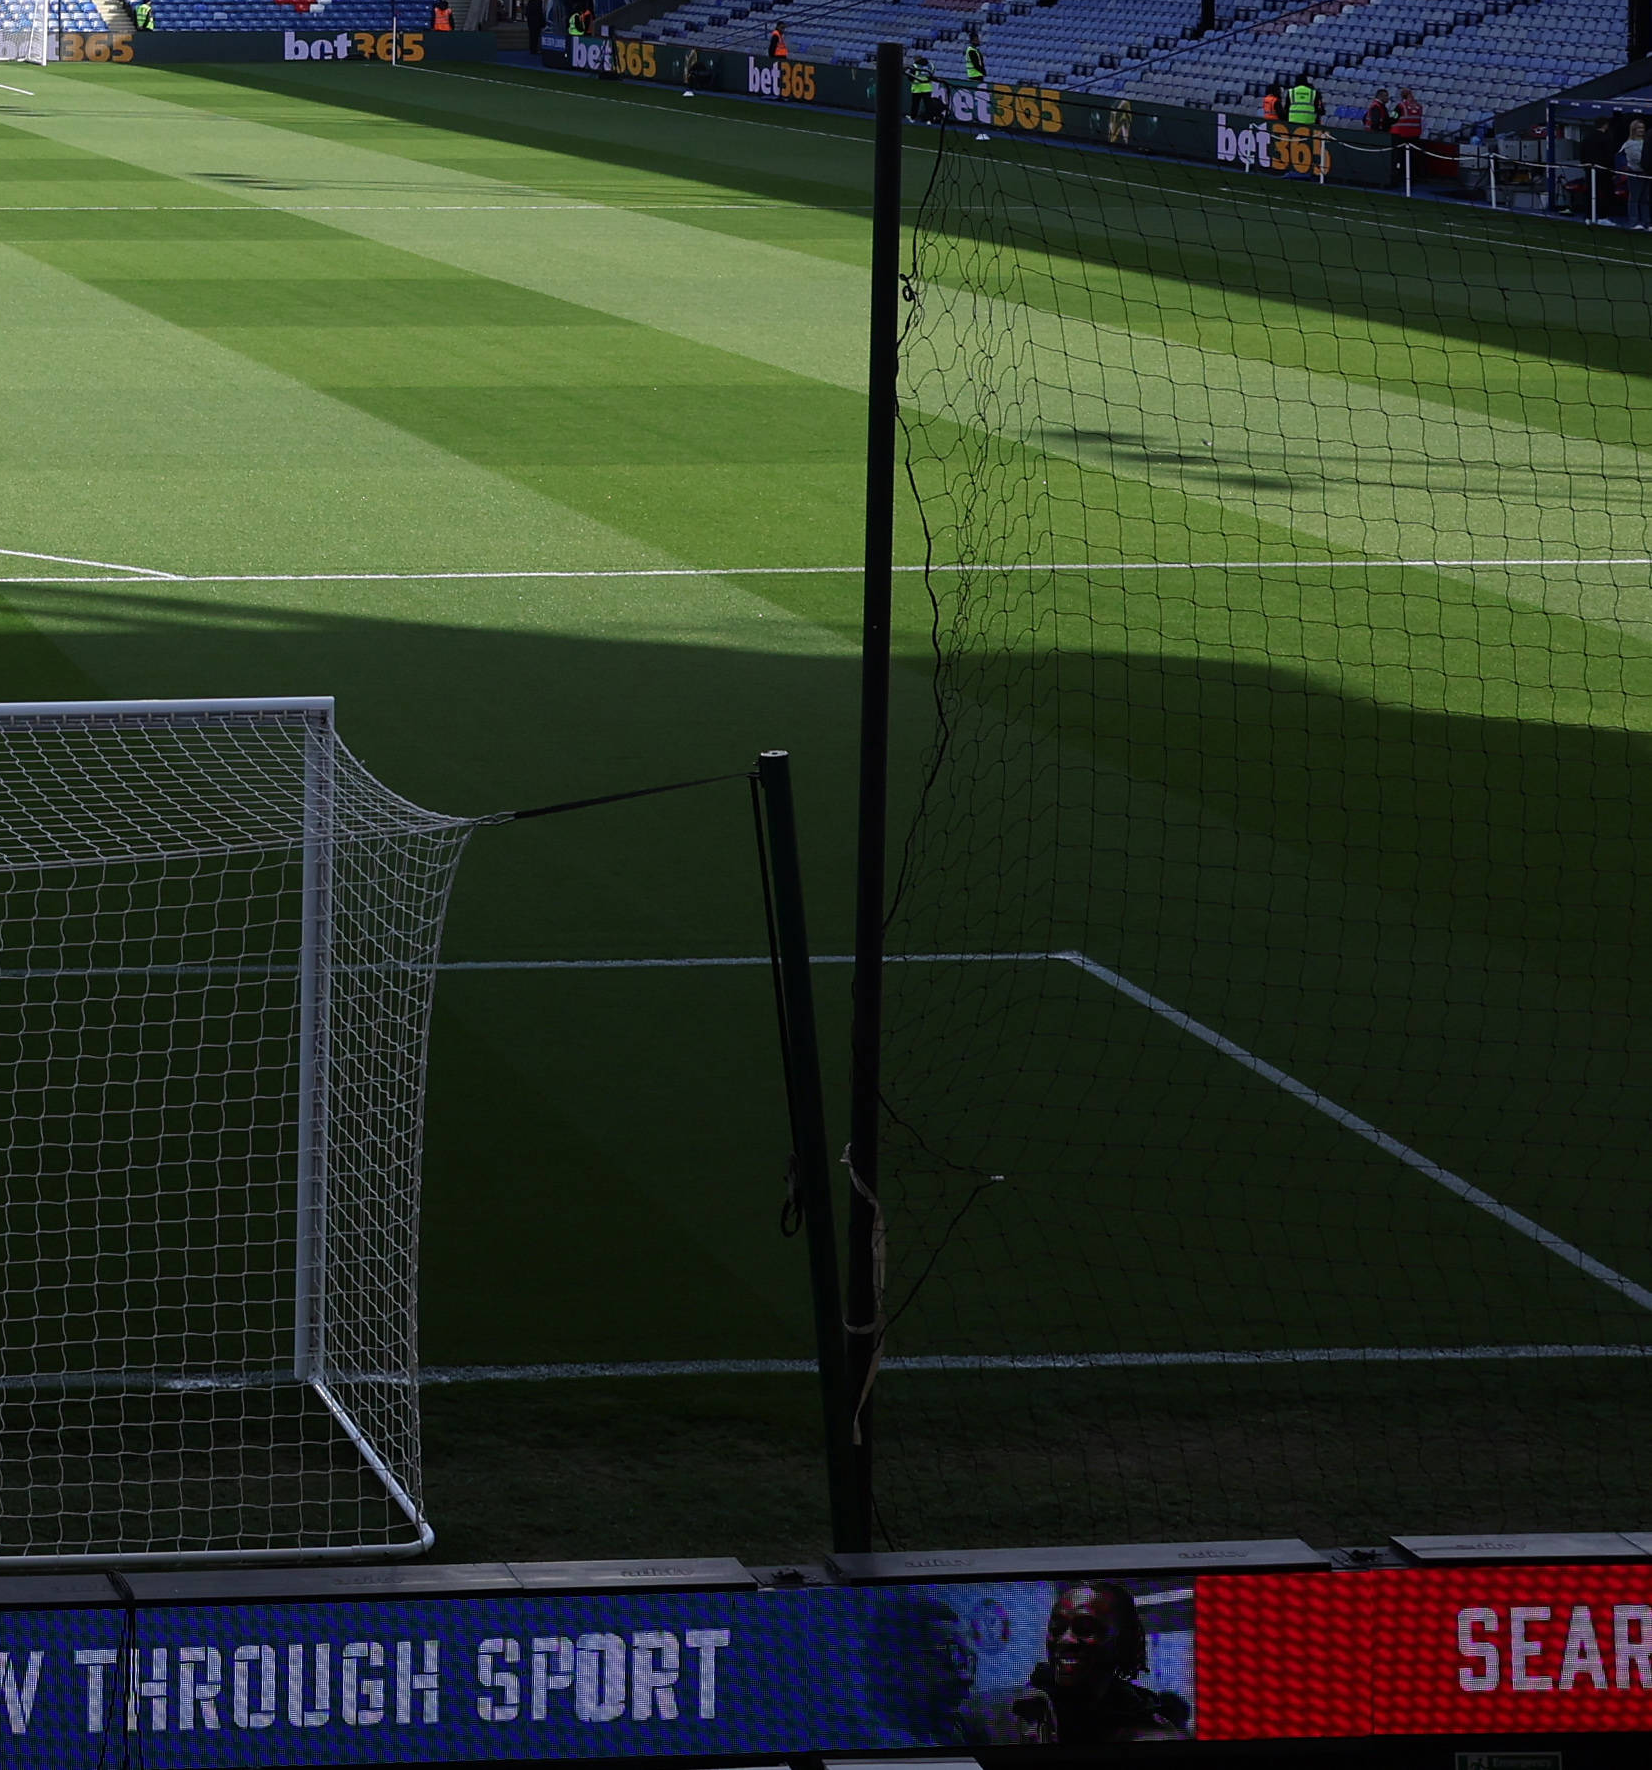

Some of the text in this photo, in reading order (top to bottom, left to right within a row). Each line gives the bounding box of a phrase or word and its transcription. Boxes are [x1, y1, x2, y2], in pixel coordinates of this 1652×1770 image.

[284, 31, 425, 62] bet365
[748, 56, 817, 102] bet365
[1217, 113, 1333, 176] bet365
[1457, 1604, 1652, 1692] SEAR
[73, 1639, 441, 1734] THROUGH
[477, 1628, 732, 1723] SPORT
